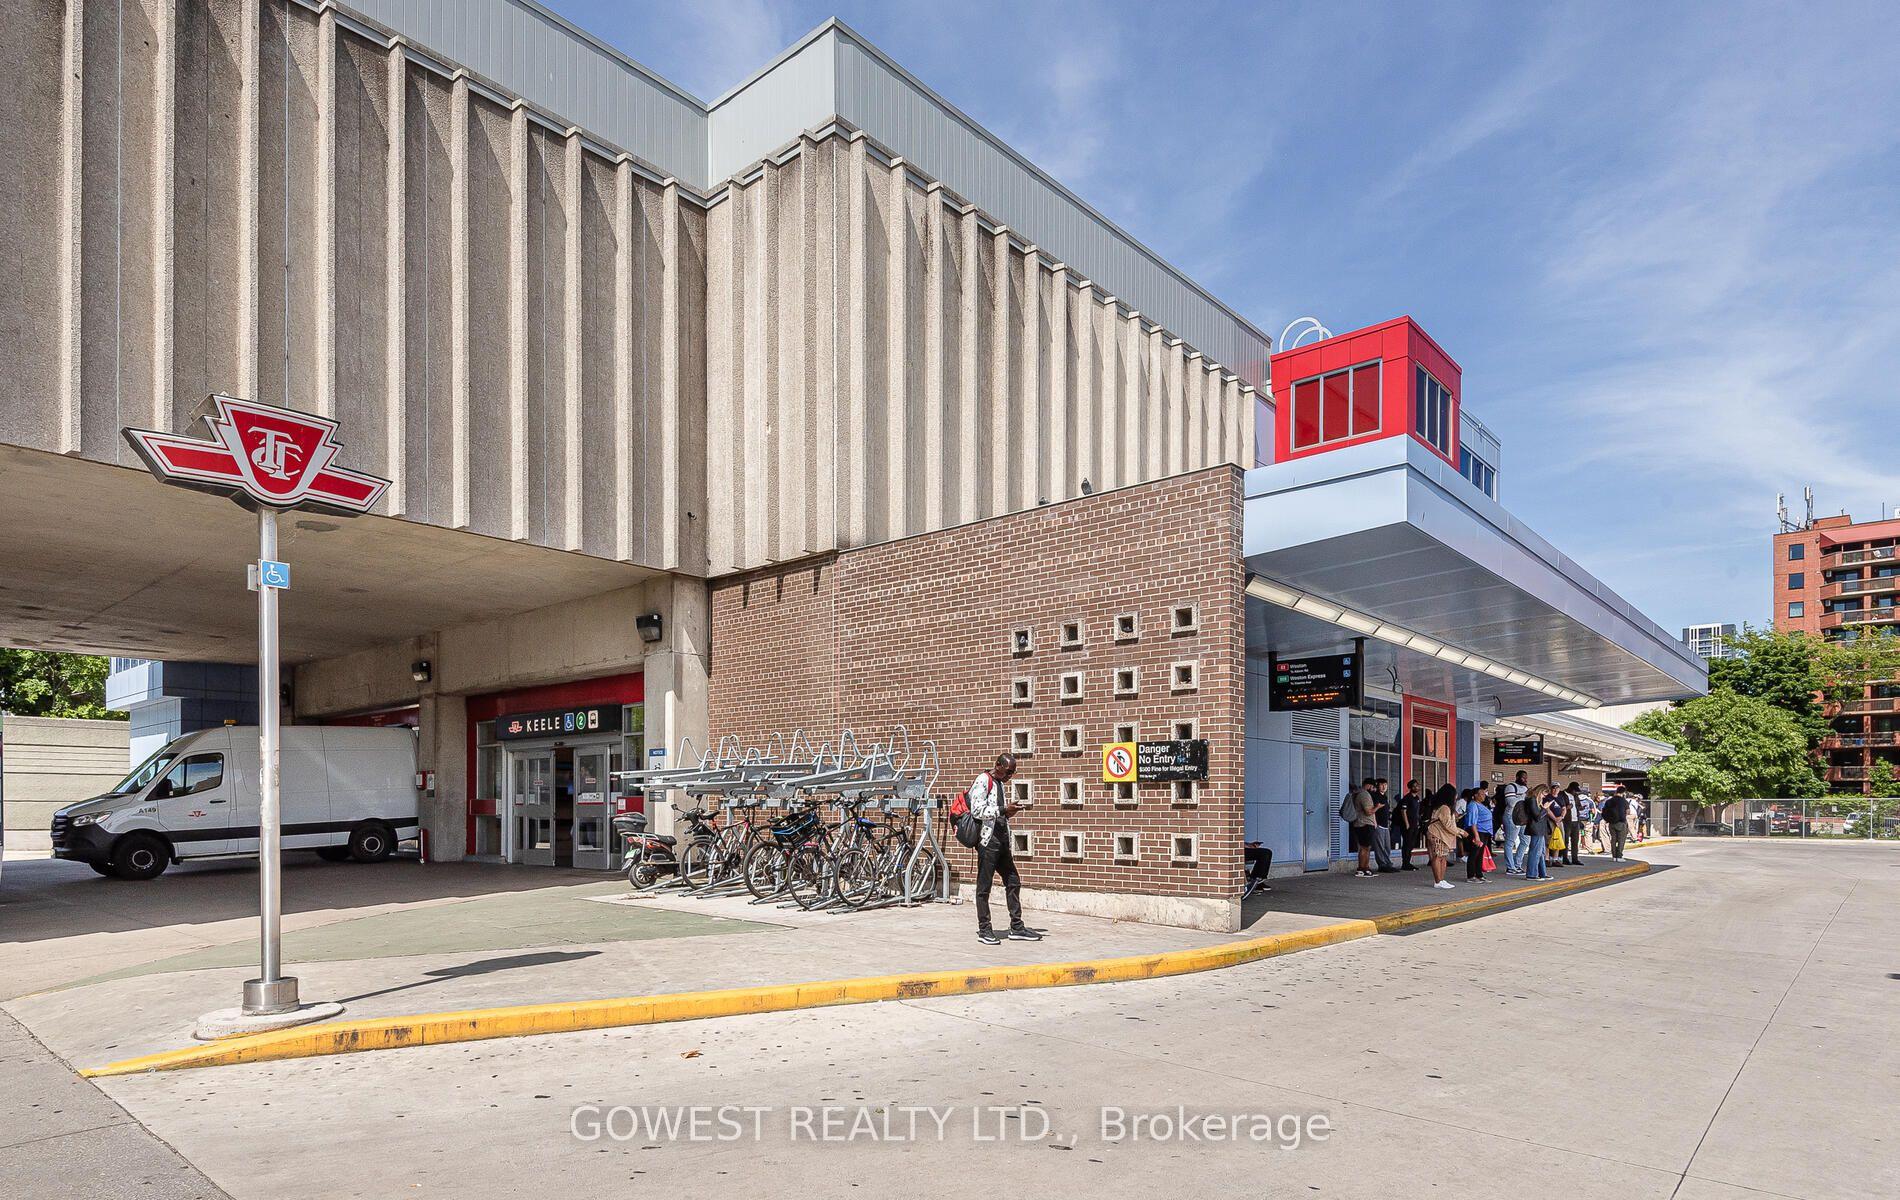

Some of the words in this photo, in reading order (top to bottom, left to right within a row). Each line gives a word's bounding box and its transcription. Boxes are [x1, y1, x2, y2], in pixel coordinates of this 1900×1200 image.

[526, 716, 560, 733] KEELE
[578, 716, 584, 726] 2
[1138, 745, 1170, 754] Danger
[1138, 755, 1151, 764] No
[1153, 754, 1176, 765] Entry
[1185, 764, 1198, 772] Entry
